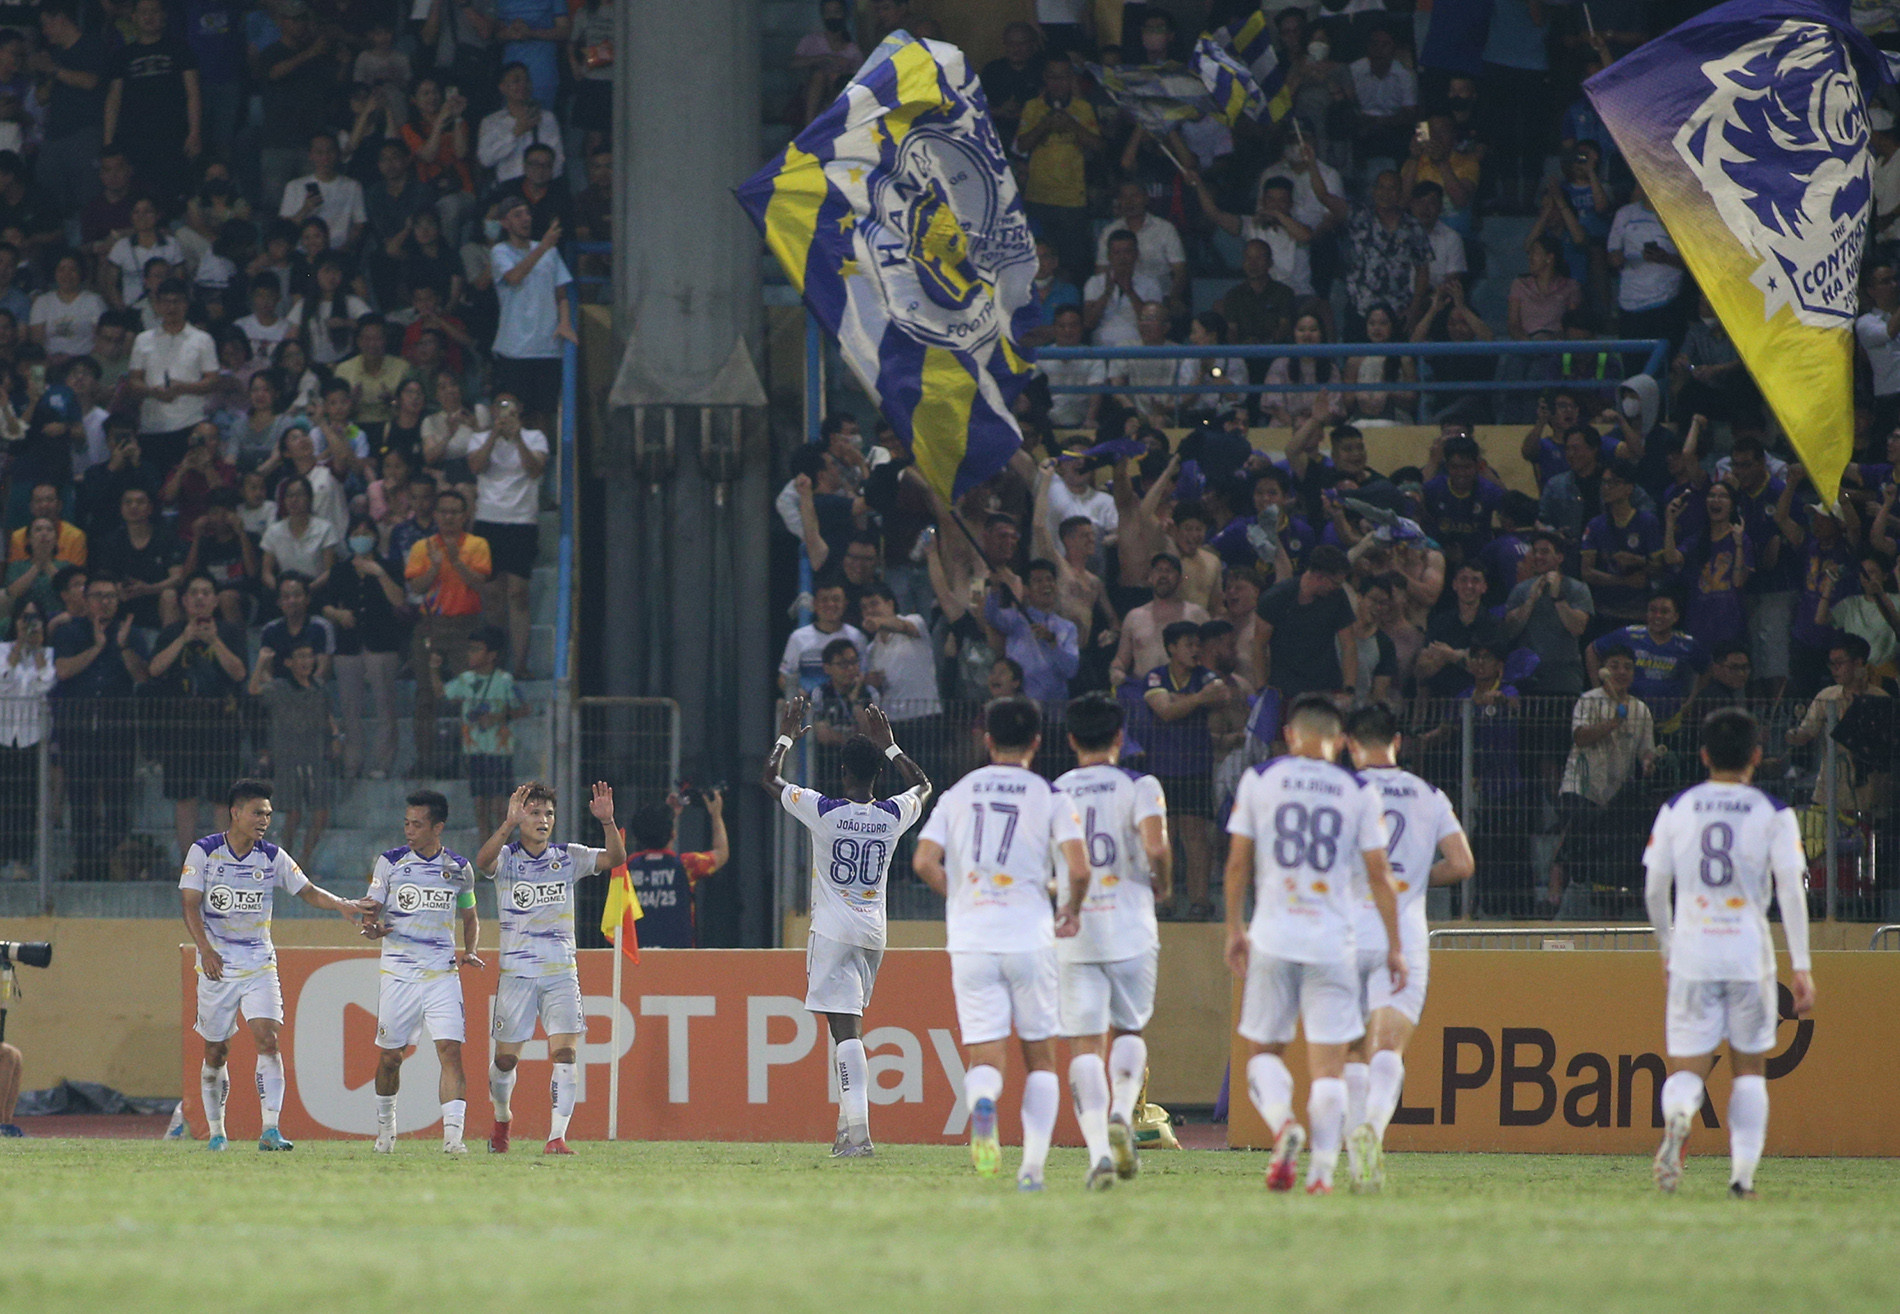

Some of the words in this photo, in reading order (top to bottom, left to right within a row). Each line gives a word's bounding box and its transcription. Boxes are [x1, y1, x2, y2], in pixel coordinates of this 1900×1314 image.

[836, 818, 860, 832] JOÃO
[861, 823, 887, 833] PEDRO
[972, 802, 1019, 866] 17
[1086, 806, 1116, 868] 6
[1275, 802, 1342, 873] 88
[1383, 810, 1406, 872] 2
[830, 838, 886, 885] 80
[1700, 821, 1733, 887] 8
[235, 891, 263, 903] T&T
[422, 889, 453, 902] T&T
[536, 883, 565, 896] T&T
[234, 903, 262, 911] HOMES
[422, 901, 451, 909] HOMES
[536, 895, 566, 904] HOMES
